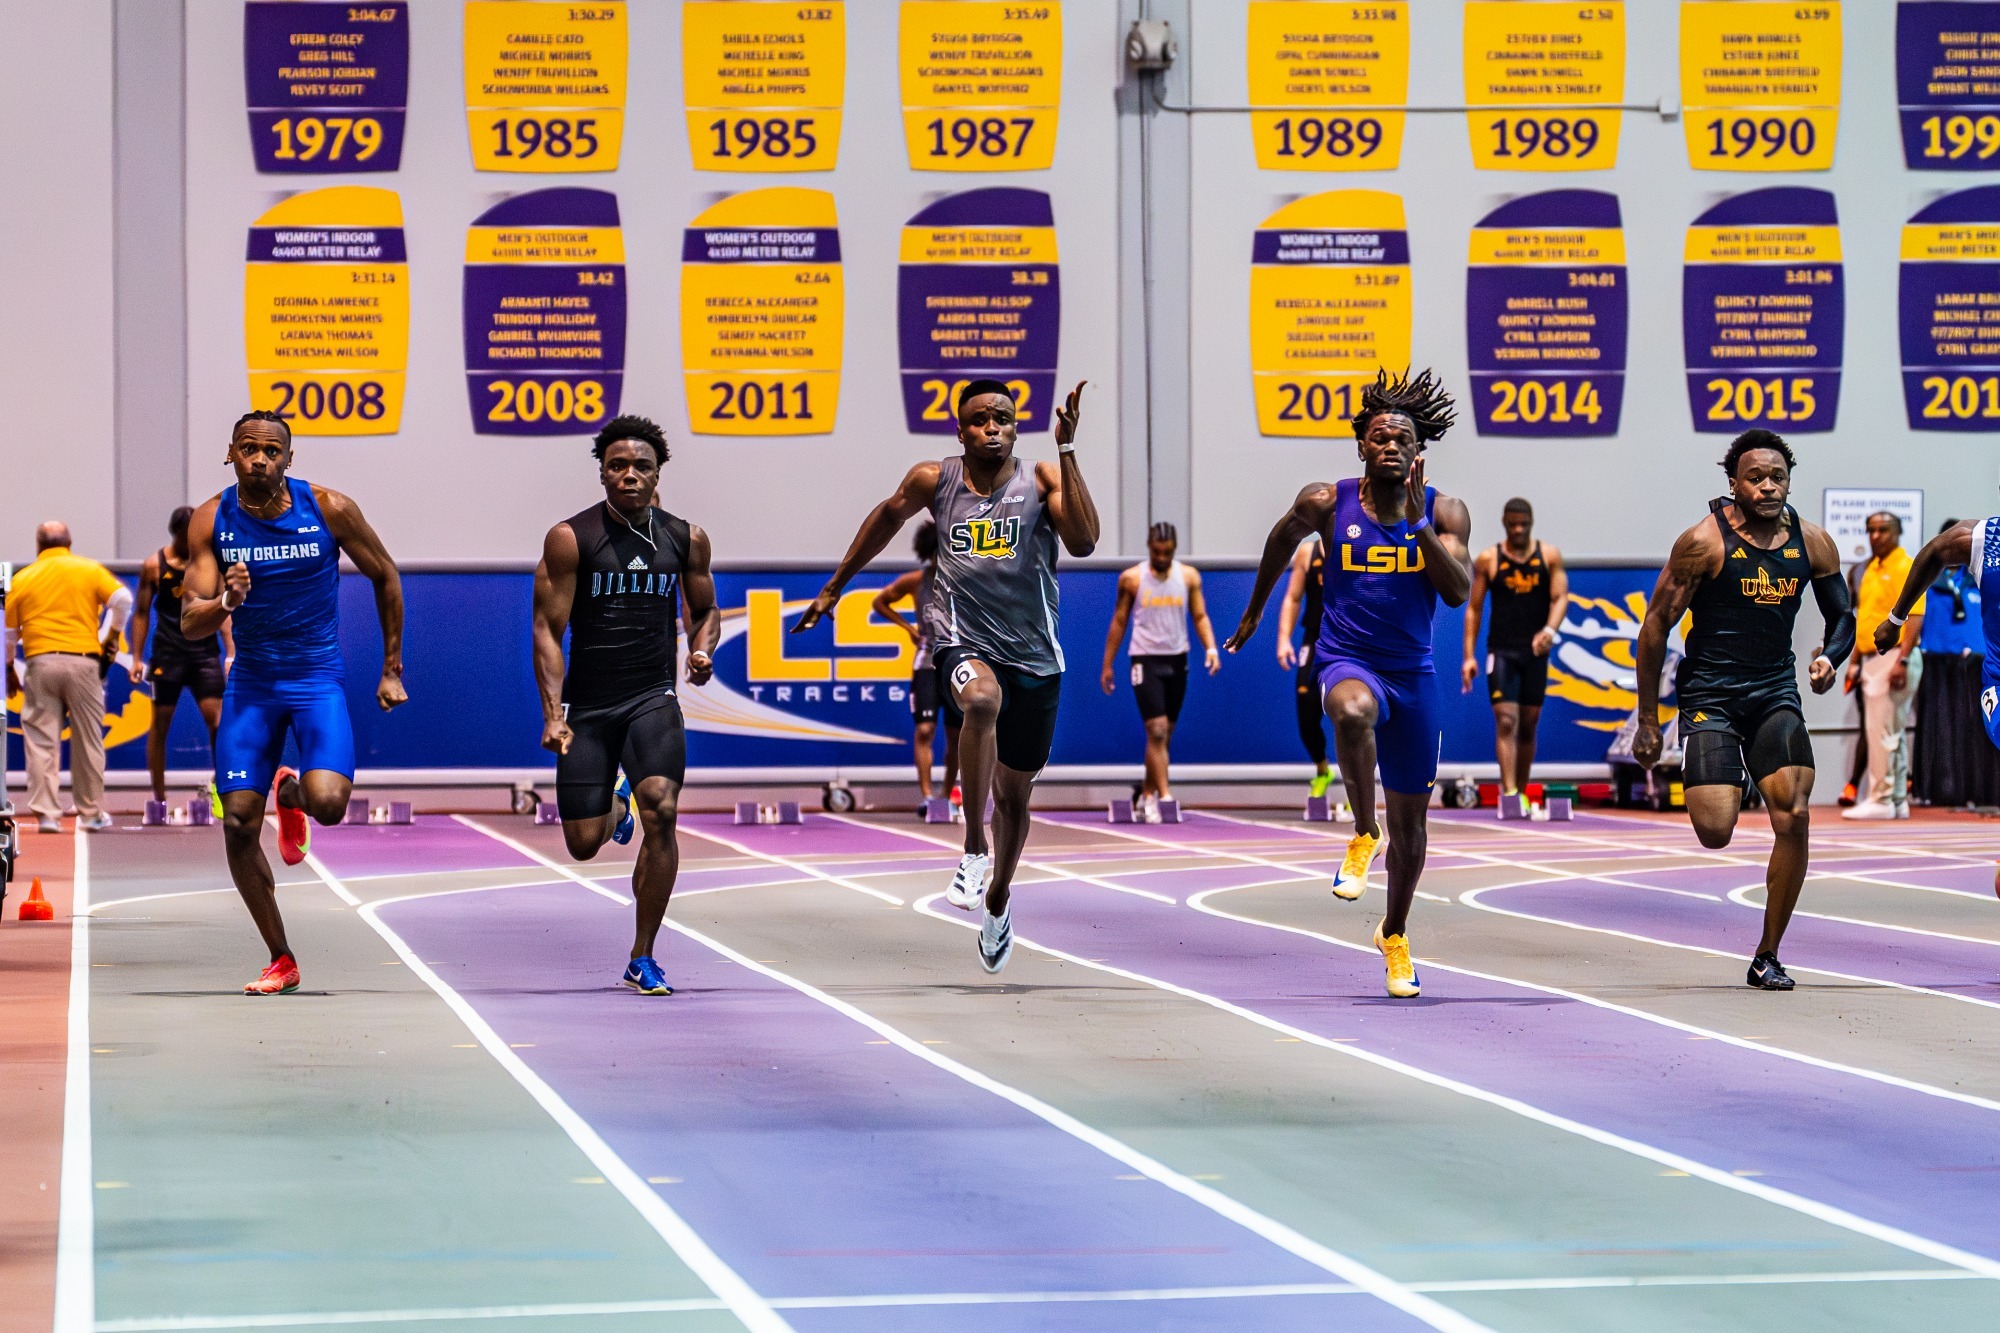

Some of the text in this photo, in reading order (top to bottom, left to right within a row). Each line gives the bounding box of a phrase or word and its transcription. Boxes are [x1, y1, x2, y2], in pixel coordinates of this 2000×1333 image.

[272, 118, 382, 160] 1979
[492, 119, 598, 159] 1985
[709, 118, 818, 159] 1985
[927, 118, 1035, 159] 1987
[1274, 118, 1383, 159] 1989
[1490, 118, 1600, 159] 1989
[1707, 117, 1815, 158] 1990
[274, 232, 376, 243] WOMEN'S INDOOR
[306, 246, 345, 257] METER
[346, 246, 382, 257] RELAY
[704, 233, 816, 244] WOMEN'S OUTDOOR
[741, 247, 780, 258] METER
[781, 247, 816, 258] RELAY
[1279, 234, 1380, 246] WOMEN'S INDOOR
[1311, 248, 1350, 260] METER
[1350, 248, 1385, 260] RELAY
[321, 297, 379, 306] LAWRENCE
[339, 314, 383, 323] MORRIS
[326, 331, 374, 340] THOMAS
[334, 348, 379, 357] WILSON
[488, 347, 603, 358] RICHARD THOMPSON
[271, 381, 386, 420] 2008
[487, 380, 605, 423] 2008
[709, 381, 814, 420] 2011
[922, 379, 1034, 421] 202
[1278, 382, 1371, 421] 201
[1490, 380, 1602, 424] 2014
[1706, 378, 1816, 421] 2015
[221, 543, 320, 563] NEW ORLEANS
[950, 516, 1021, 557] SLU
[1341, 543, 1426, 573] LSU
[747, 588, 917, 681] LS
[955, 666, 970, 685] 6
